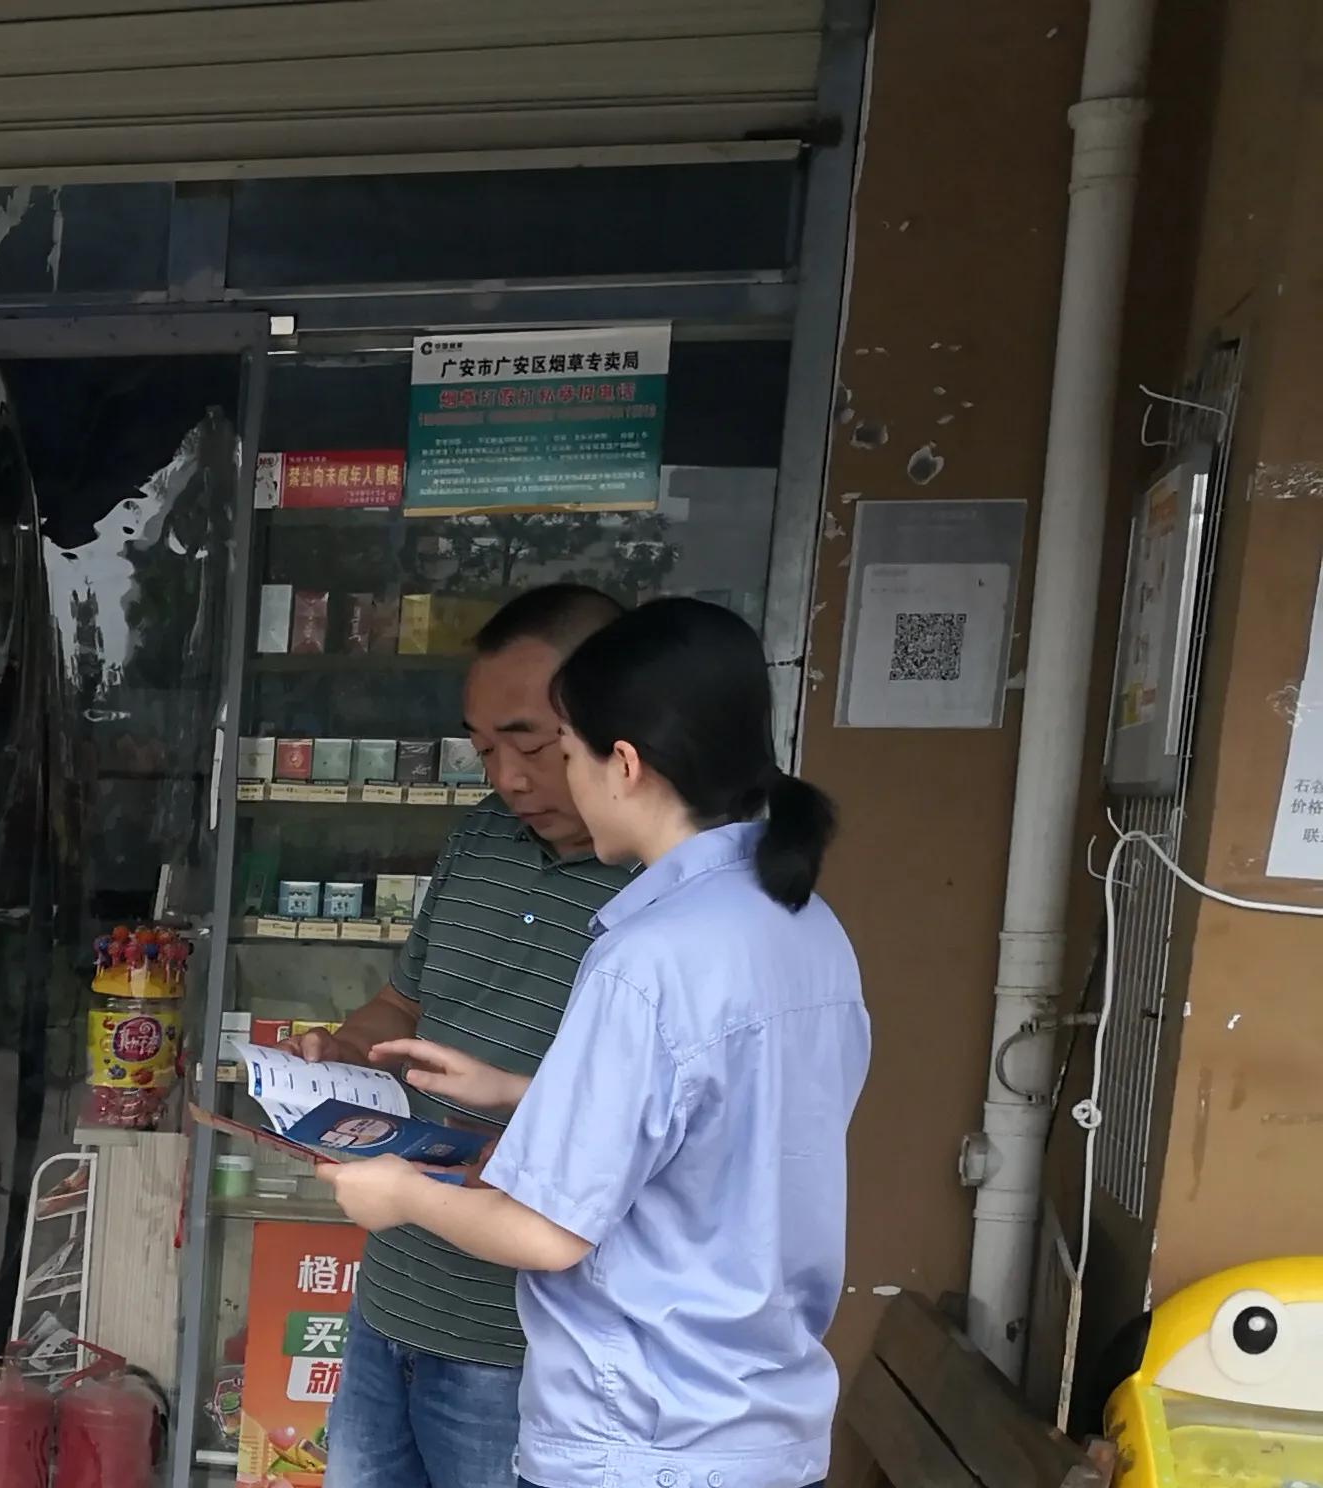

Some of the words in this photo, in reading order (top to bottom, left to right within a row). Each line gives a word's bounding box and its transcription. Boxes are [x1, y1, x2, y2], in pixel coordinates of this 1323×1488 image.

[440, 350, 640, 379] 广安市广安区烟草专卖局
[1302, 826, 1323, 843] 联
[302, 1316, 348, 1352] 买
